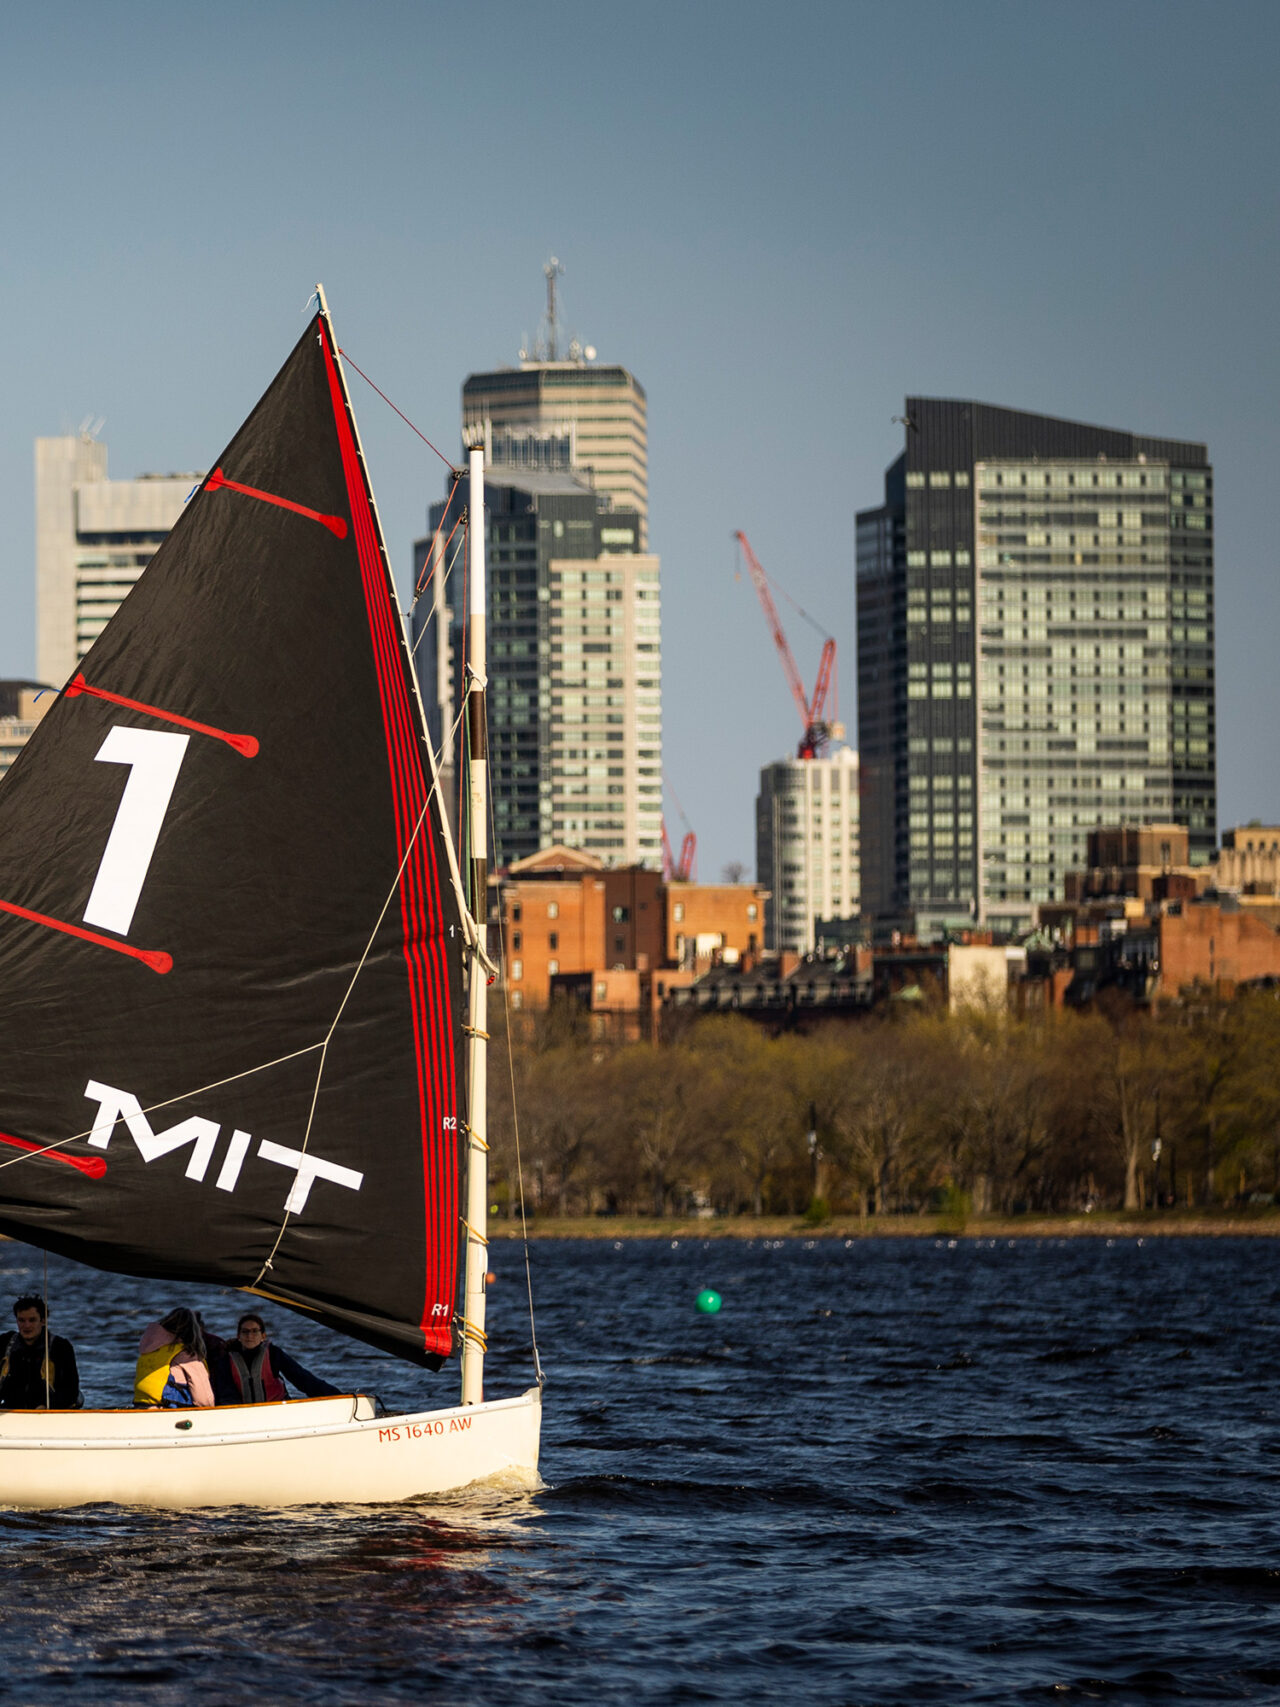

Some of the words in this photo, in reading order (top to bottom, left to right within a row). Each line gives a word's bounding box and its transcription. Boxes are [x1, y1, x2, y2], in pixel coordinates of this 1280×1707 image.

[316, 333, 323, 347] 1
[82, 725, 191, 936] 1
[449, 924, 455, 938] 1
[442, 1116, 457, 1130] R2
[83, 1079, 364, 1215] MIT
[431, 1303, 449, 1317] R1
[378, 1427, 401, 1443] MS
[405, 1421, 444, 1439] 1640
[449, 1416, 472, 1433] AW
